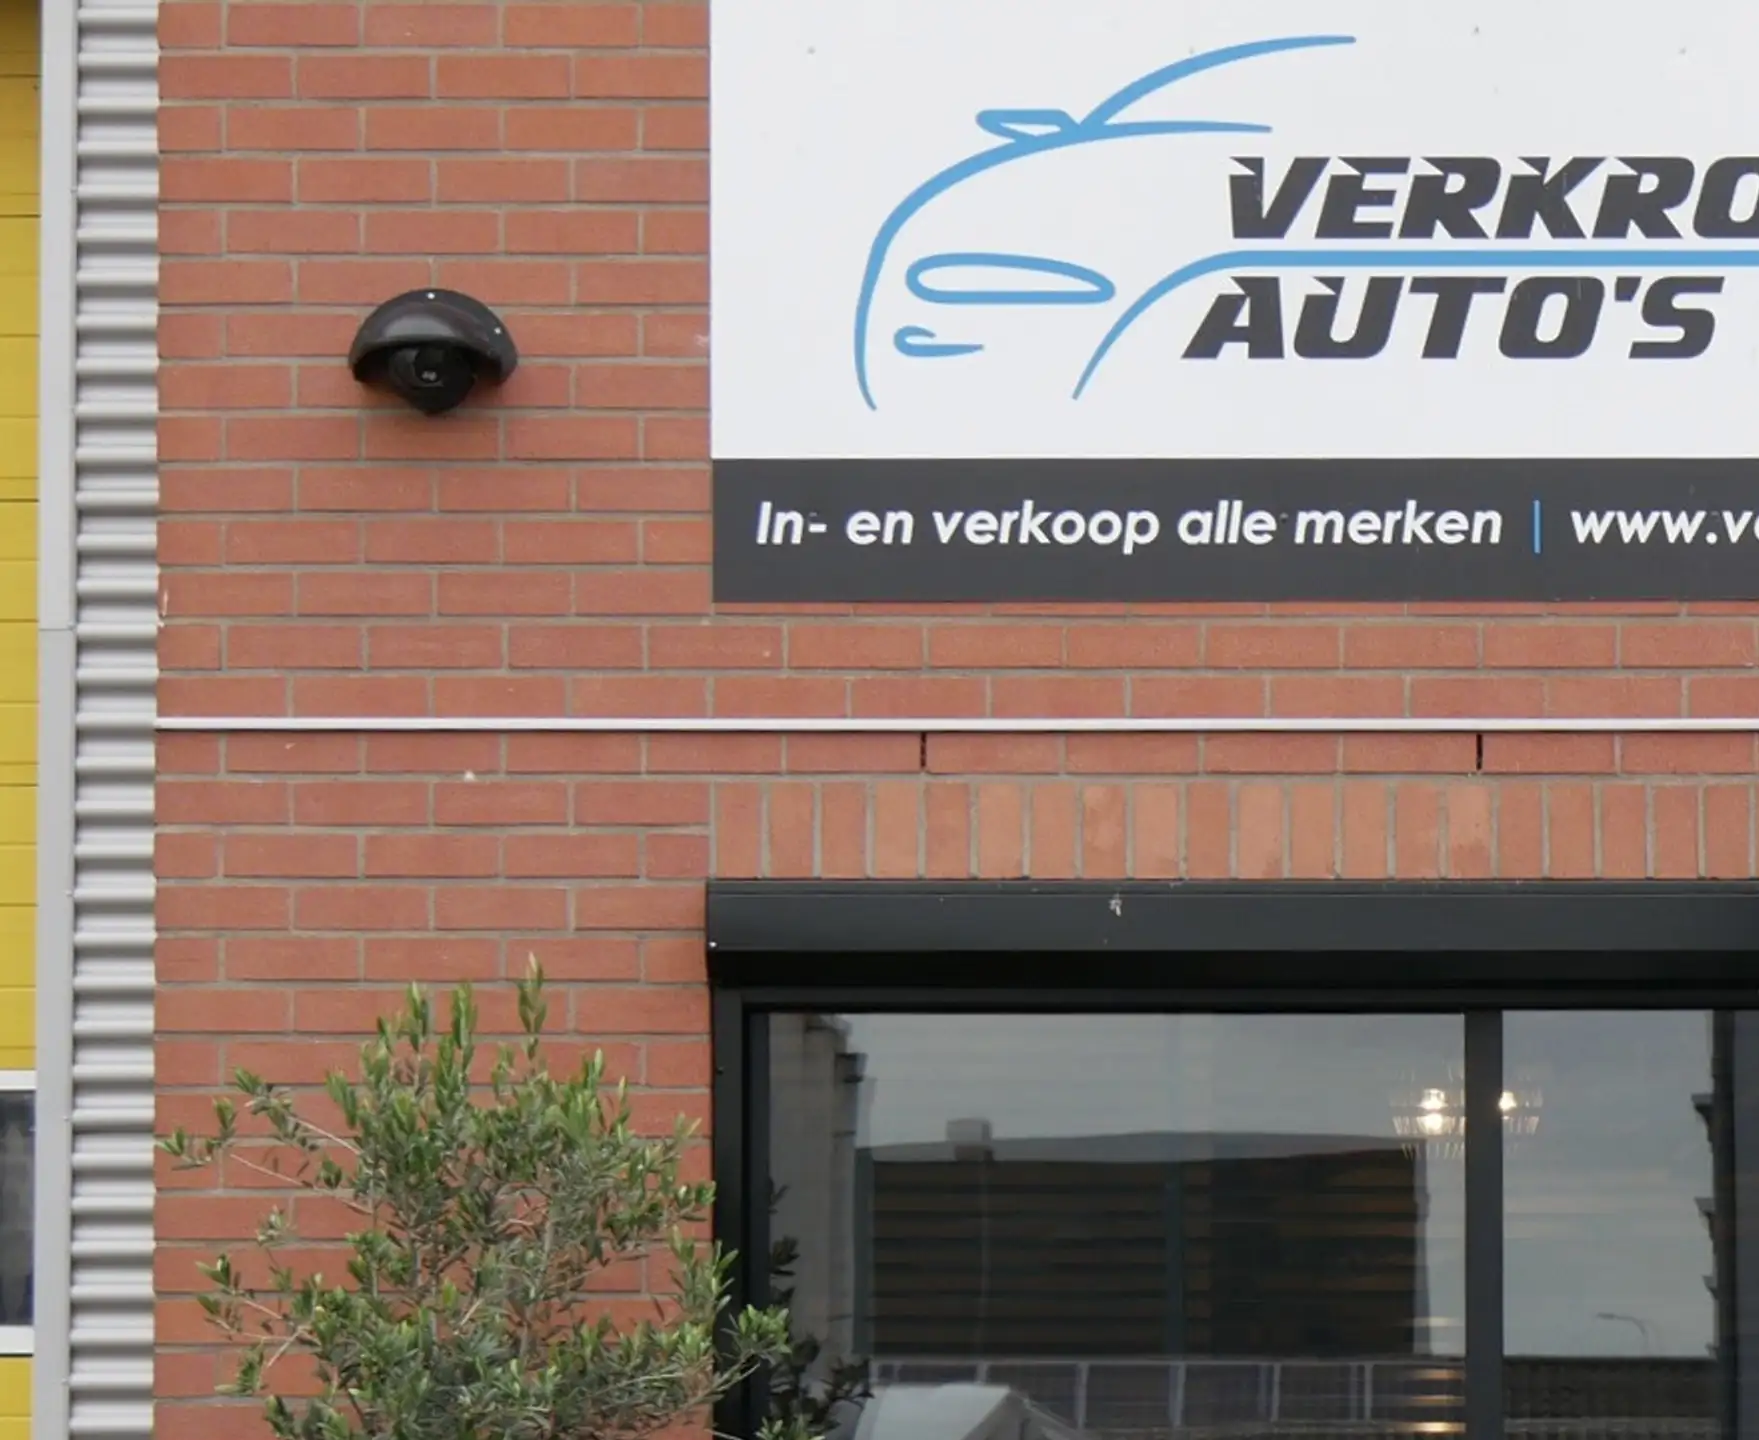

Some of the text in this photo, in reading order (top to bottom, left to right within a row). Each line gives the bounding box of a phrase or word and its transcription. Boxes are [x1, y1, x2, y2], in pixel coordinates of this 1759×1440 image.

[1182, 276, 1724, 359] AUTO'S
[757, 499, 1502, 555] In- en verkoop alle merken
